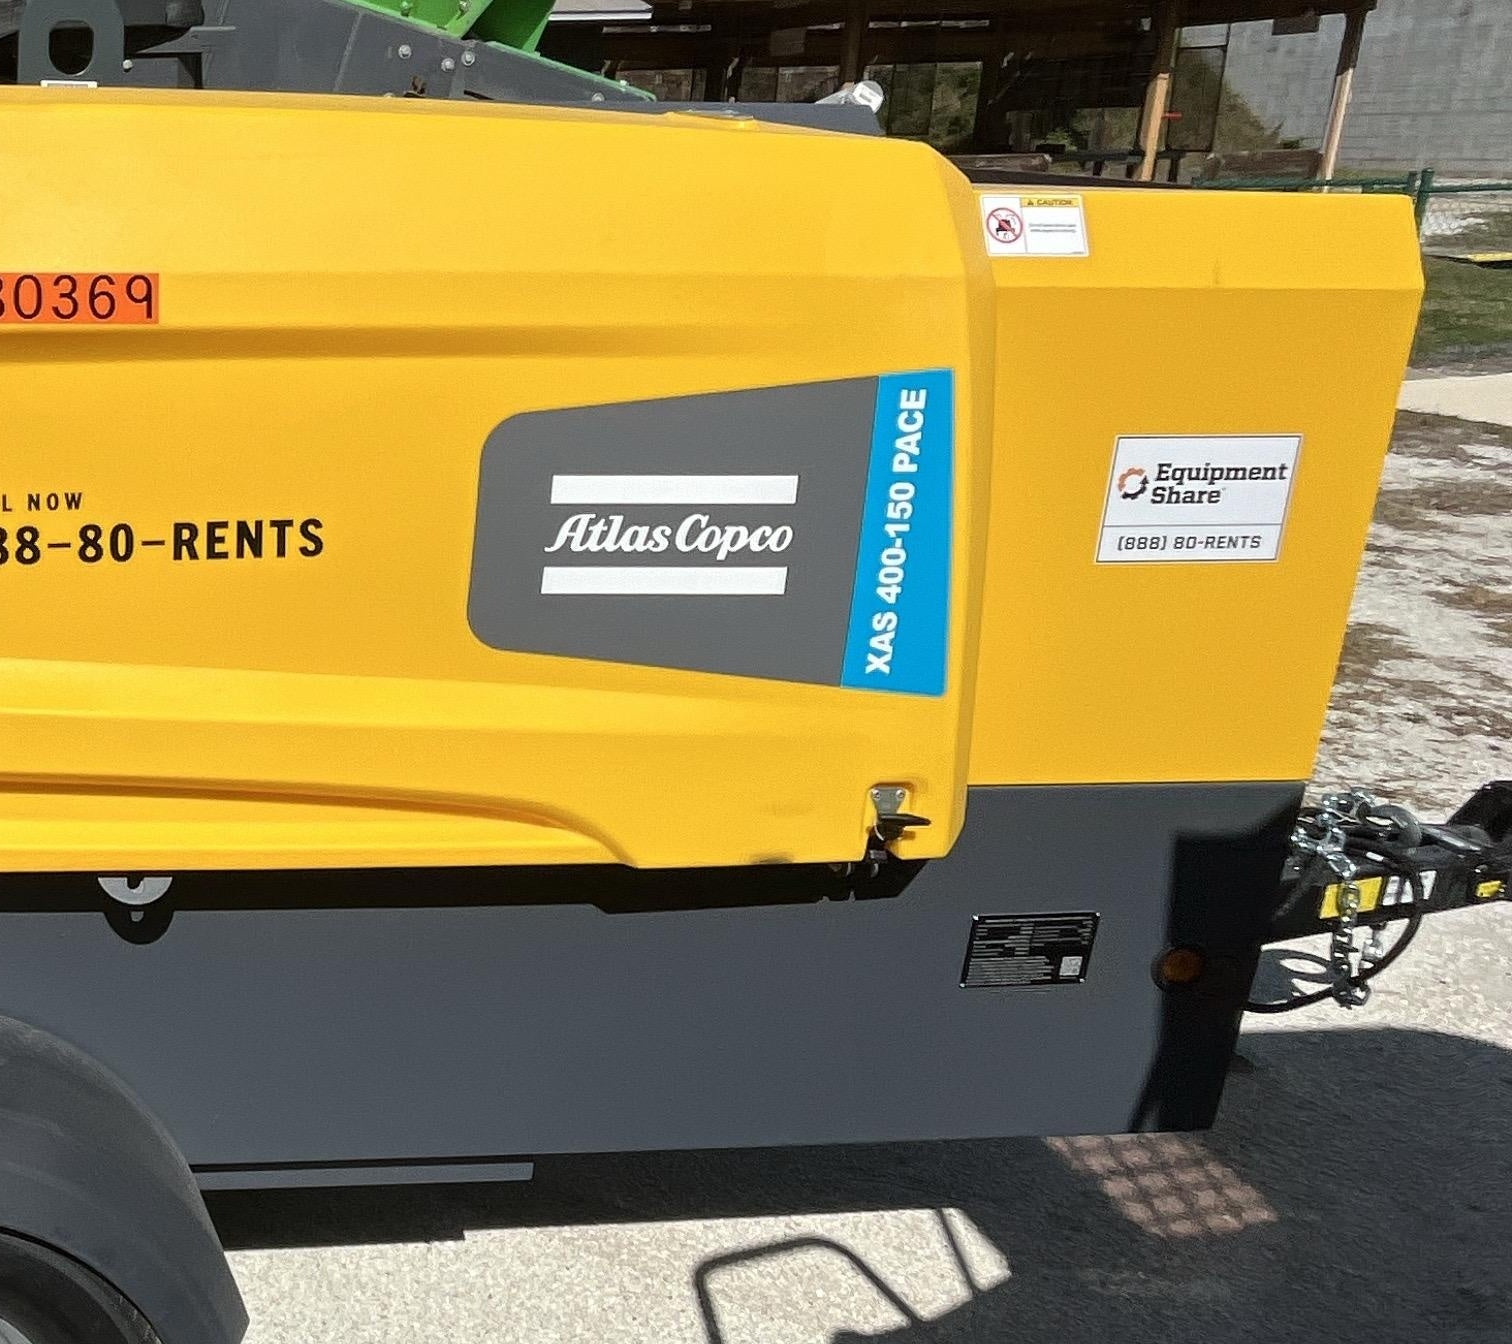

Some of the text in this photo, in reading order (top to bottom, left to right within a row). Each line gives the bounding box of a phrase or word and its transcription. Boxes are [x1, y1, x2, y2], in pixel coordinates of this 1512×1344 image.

[1154, 462, 1289, 485] Equipment
[27, 492, 83, 512] NOW
[1150, 486, 1221, 505] Share
[865, 388, 928, 675] XAS 400-150 PACE
[1117, 535, 1262, 551] (888) 80-RENTS
